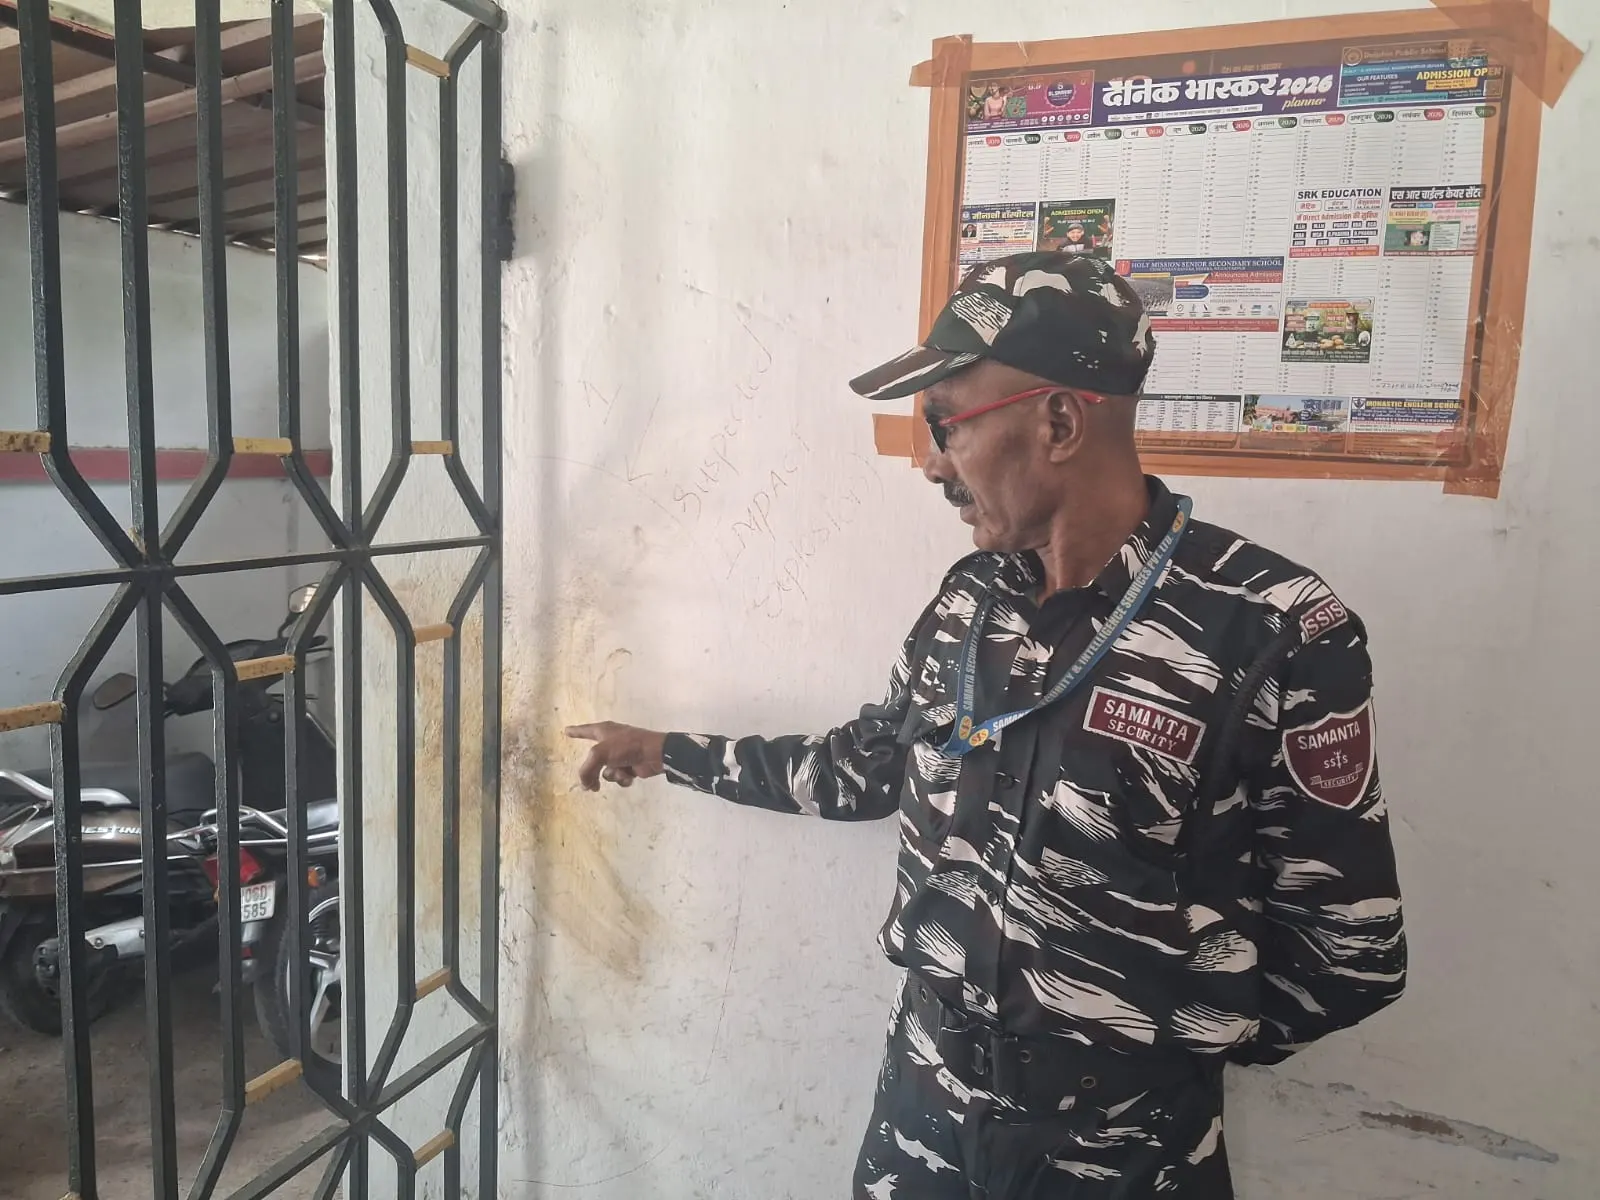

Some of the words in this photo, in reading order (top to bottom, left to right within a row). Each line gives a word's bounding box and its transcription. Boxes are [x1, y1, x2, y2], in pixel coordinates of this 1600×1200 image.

[1102, 78, 1181, 106] दैनिक
[1184, 73, 1279, 100] भास्कर
[1276, 74, 1334, 96] 2026
[1416, 69, 1471, 80] ADMISSION
[1281, 97, 1327, 111] planner
[1297, 190, 1318, 199] SRK
[1321, 188, 1382, 198] EDUCATION
[1366, 400, 1403, 408] MONASTIC
[1403, 401, 1433, 409] ENGLISH
[1433, 401, 1462, 409] SCHOO
[1078, 605, 1127, 665] INTELLIGENCE
[1120, 566, 1152, 609] SERVICES
[1305, 602, 1344, 635] SSIS
[963, 673, 975, 711] SAMANTA
[1103, 699, 1189, 742] SAMANTA
[1107, 719, 1178, 752] SECURITY
[1297, 720, 1361, 750] SAMANTA
[1323, 775, 1356, 788] SECURITY
